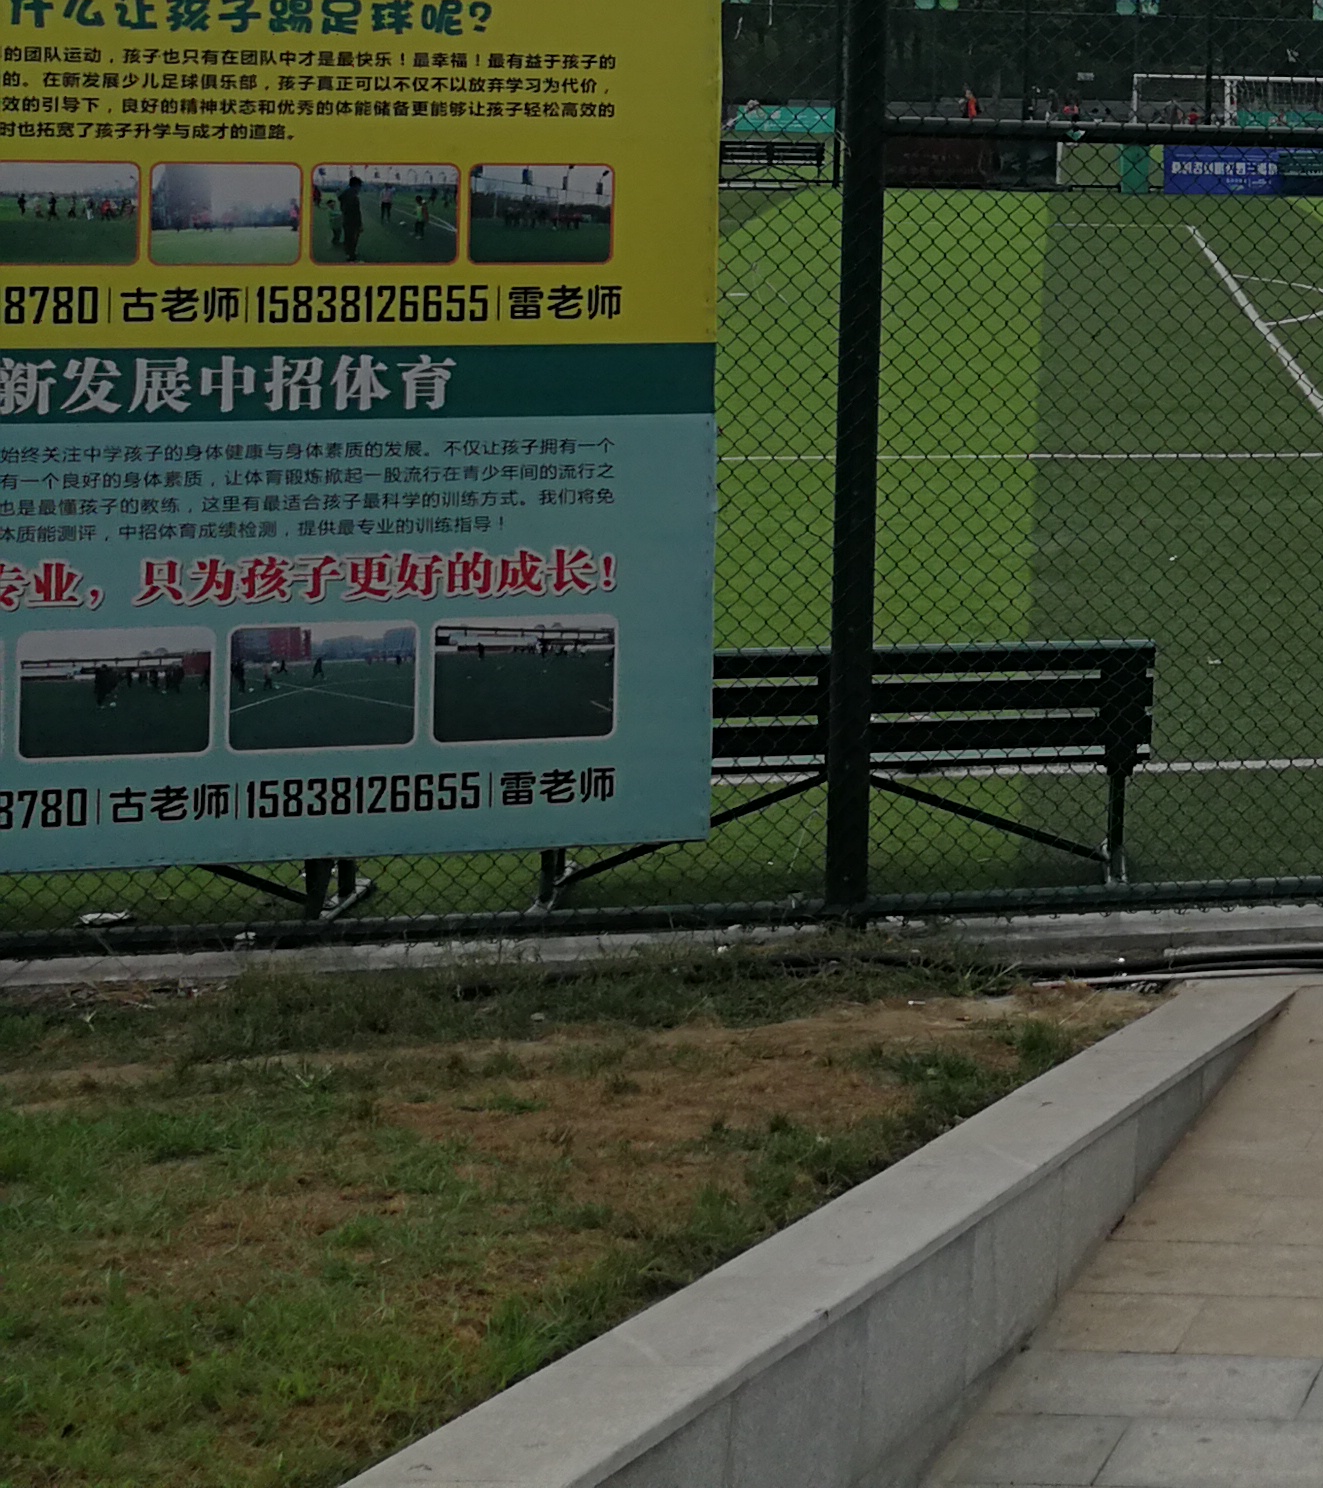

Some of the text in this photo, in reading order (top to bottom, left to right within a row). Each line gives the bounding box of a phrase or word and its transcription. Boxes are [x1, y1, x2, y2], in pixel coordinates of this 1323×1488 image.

[0, 354, 457, 414] 新发展中招体育
